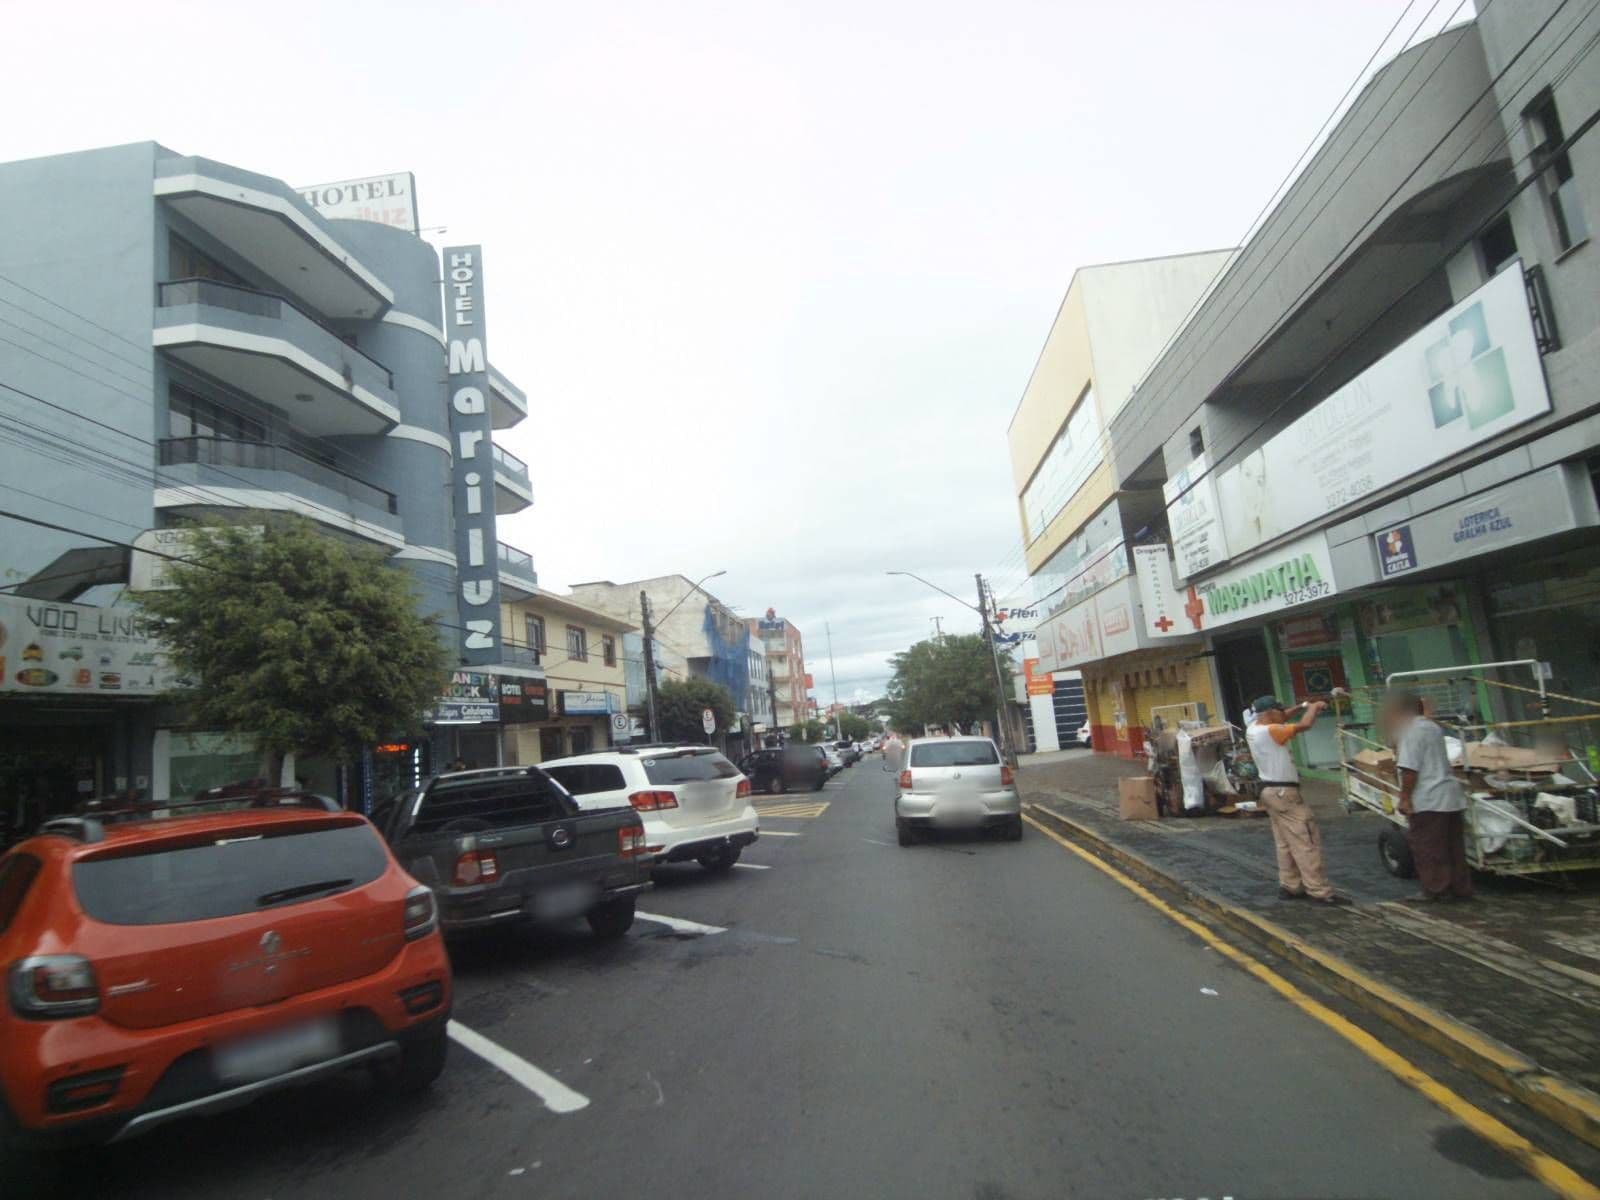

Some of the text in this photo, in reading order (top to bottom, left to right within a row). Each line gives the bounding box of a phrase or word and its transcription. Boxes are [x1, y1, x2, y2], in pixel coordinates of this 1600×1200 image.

[450, 253, 474, 326] HOTEL
[1490, 516, 1513, 531] AZUL
[1208, 554, 1322, 615] MARANATHA
[1283, 582, 1330, 606] 3272-3972
